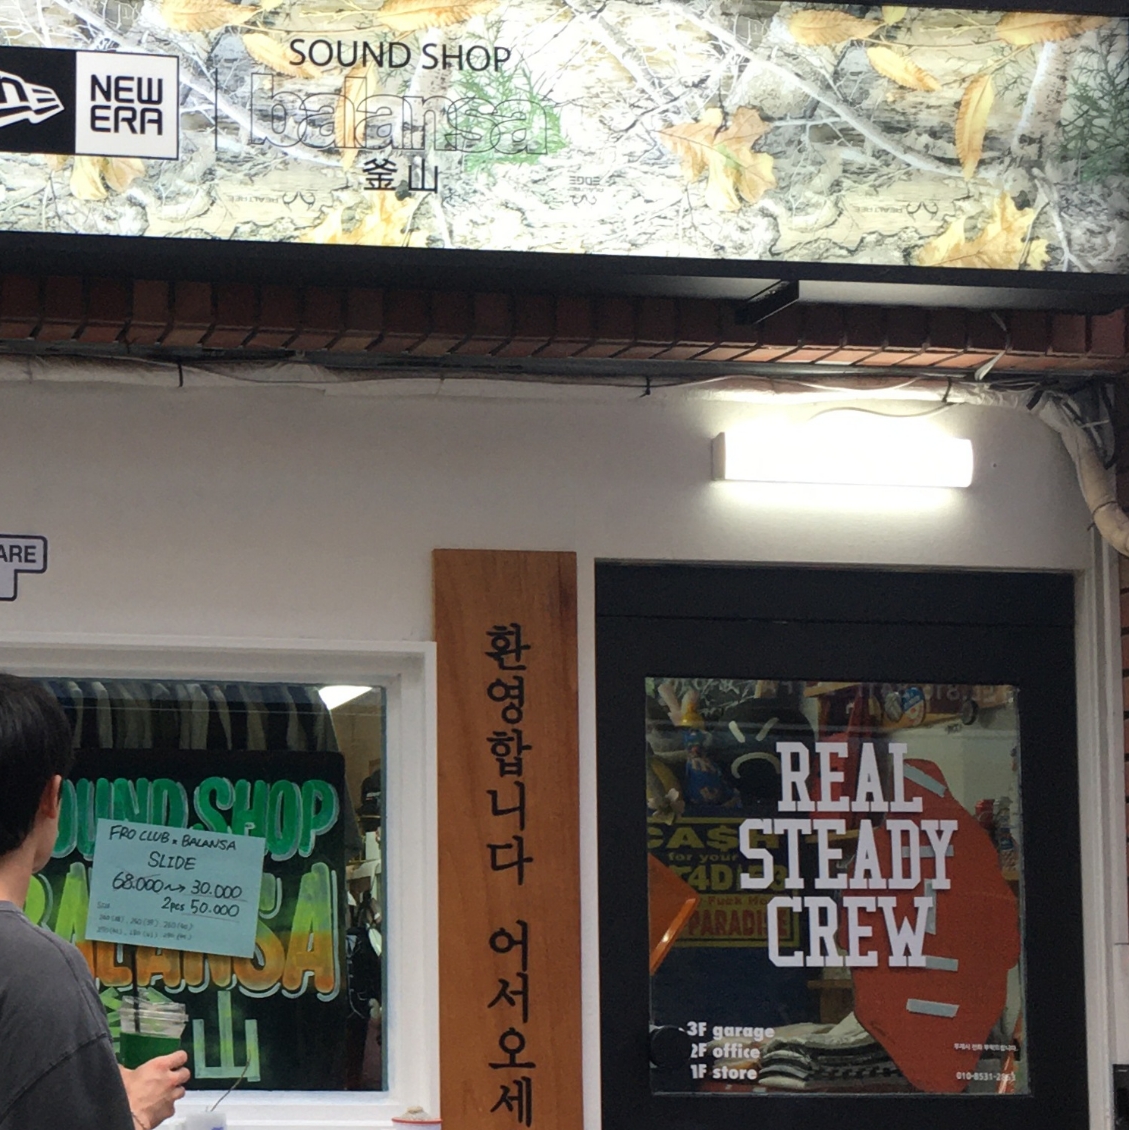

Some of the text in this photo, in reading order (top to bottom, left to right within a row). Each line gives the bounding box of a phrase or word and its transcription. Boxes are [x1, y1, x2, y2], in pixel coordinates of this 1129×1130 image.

[289, 38, 512, 72] SOUND SHOP
[90, 74, 163, 105] NEW
[90, 104, 163, 136] ERA
[250, 72, 548, 155] balansa
[363, 158, 439, 194] 釜山
[484, 622, 534, 886] 환영합니다
[775, 742, 923, 812] REAL
[194, 777, 340, 860] SHOP
[109, 825, 237, 851] FRO CLUB BALANSA
[148, 851, 197, 870] SLIDE
[738, 818, 958, 890] STEADY
[111, 871, 243, 899] 68.000 30.000
[190, 899, 240, 918] 50.000
[688, 908, 790, 937] PARADIE
[767, 896, 934, 968] CREW
[686, 1020, 775, 1042] 3F garage
[690, 1042, 760, 1058] 2F office
[690, 1063, 758, 1080] 1F store
